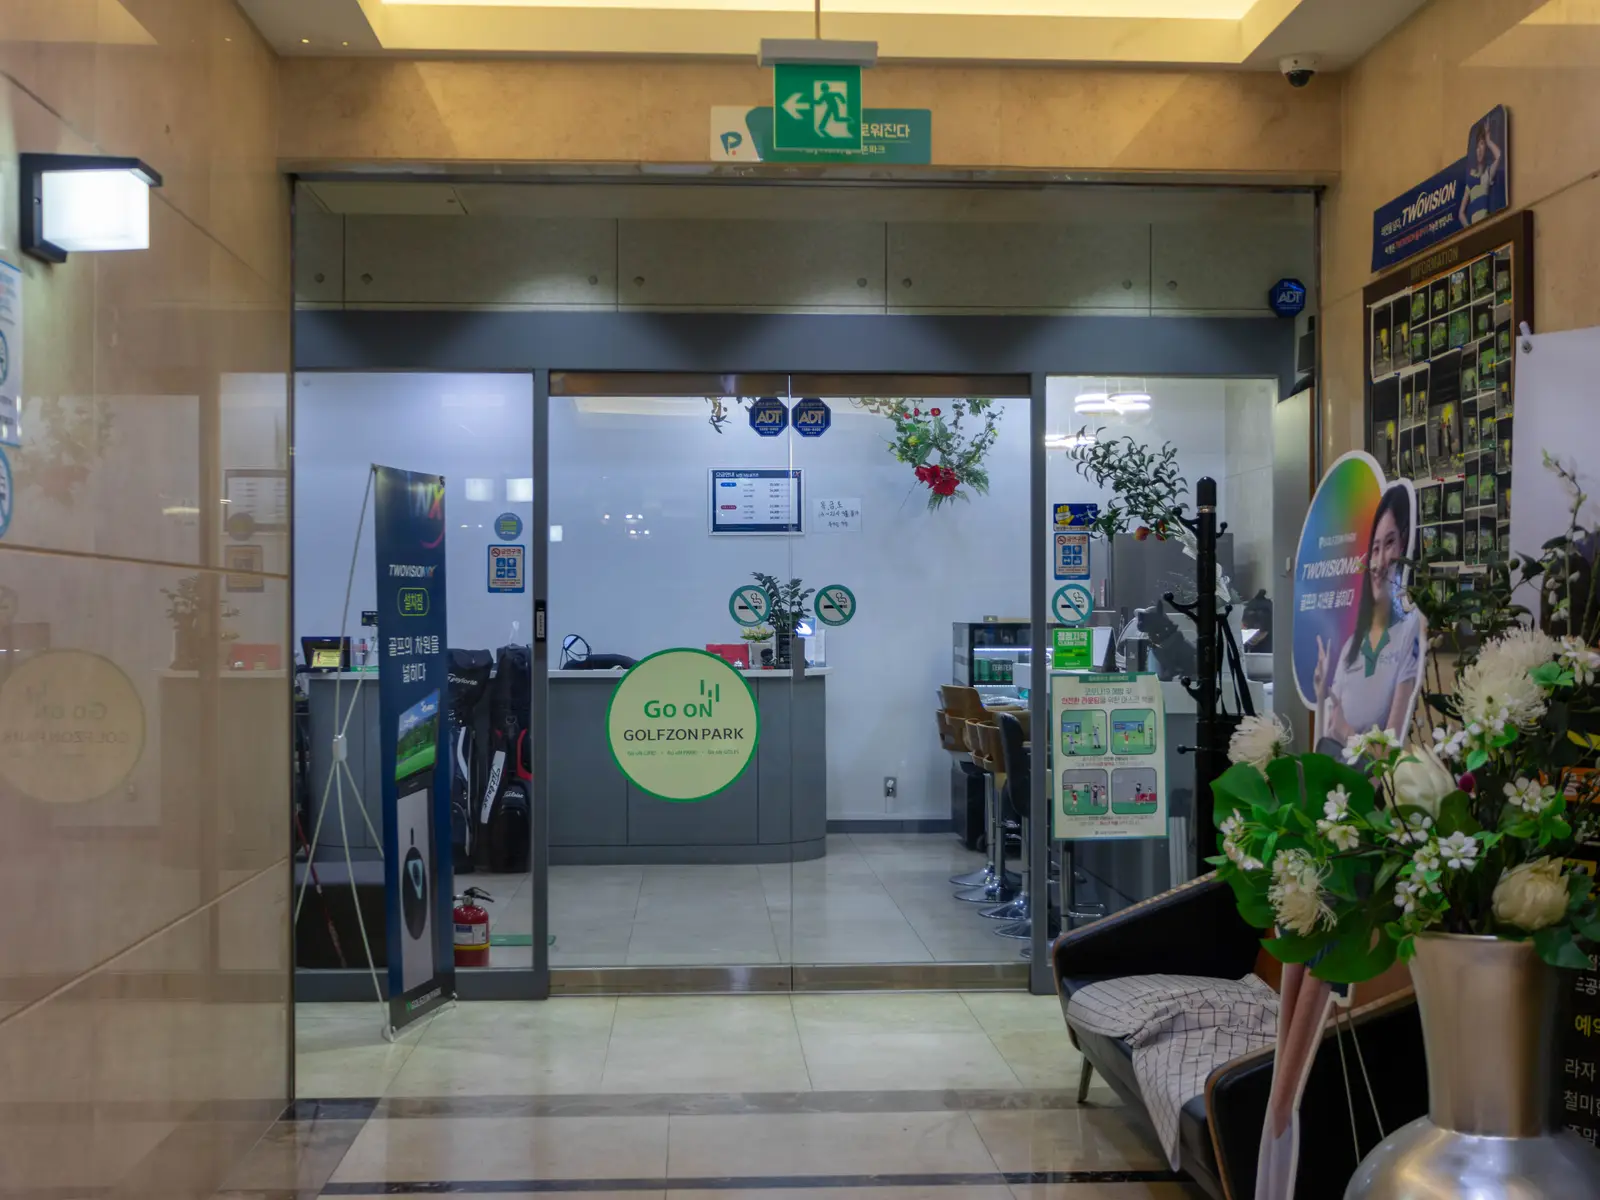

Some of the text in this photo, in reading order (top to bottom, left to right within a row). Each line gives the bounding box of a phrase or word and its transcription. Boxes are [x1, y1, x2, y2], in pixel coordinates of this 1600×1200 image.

[1401, 179, 1457, 227] TWOVISION
[1277, 290, 1303, 304] ADT
[755, 409, 783, 424] ADT
[797, 409, 825, 424] ADT
[404, 592, 424, 611] 설치점
[389, 635, 440, 657] 골프의 차원을
[402, 662, 427, 684] 넓히다
[1061, 696, 1080, 705] 안전한
